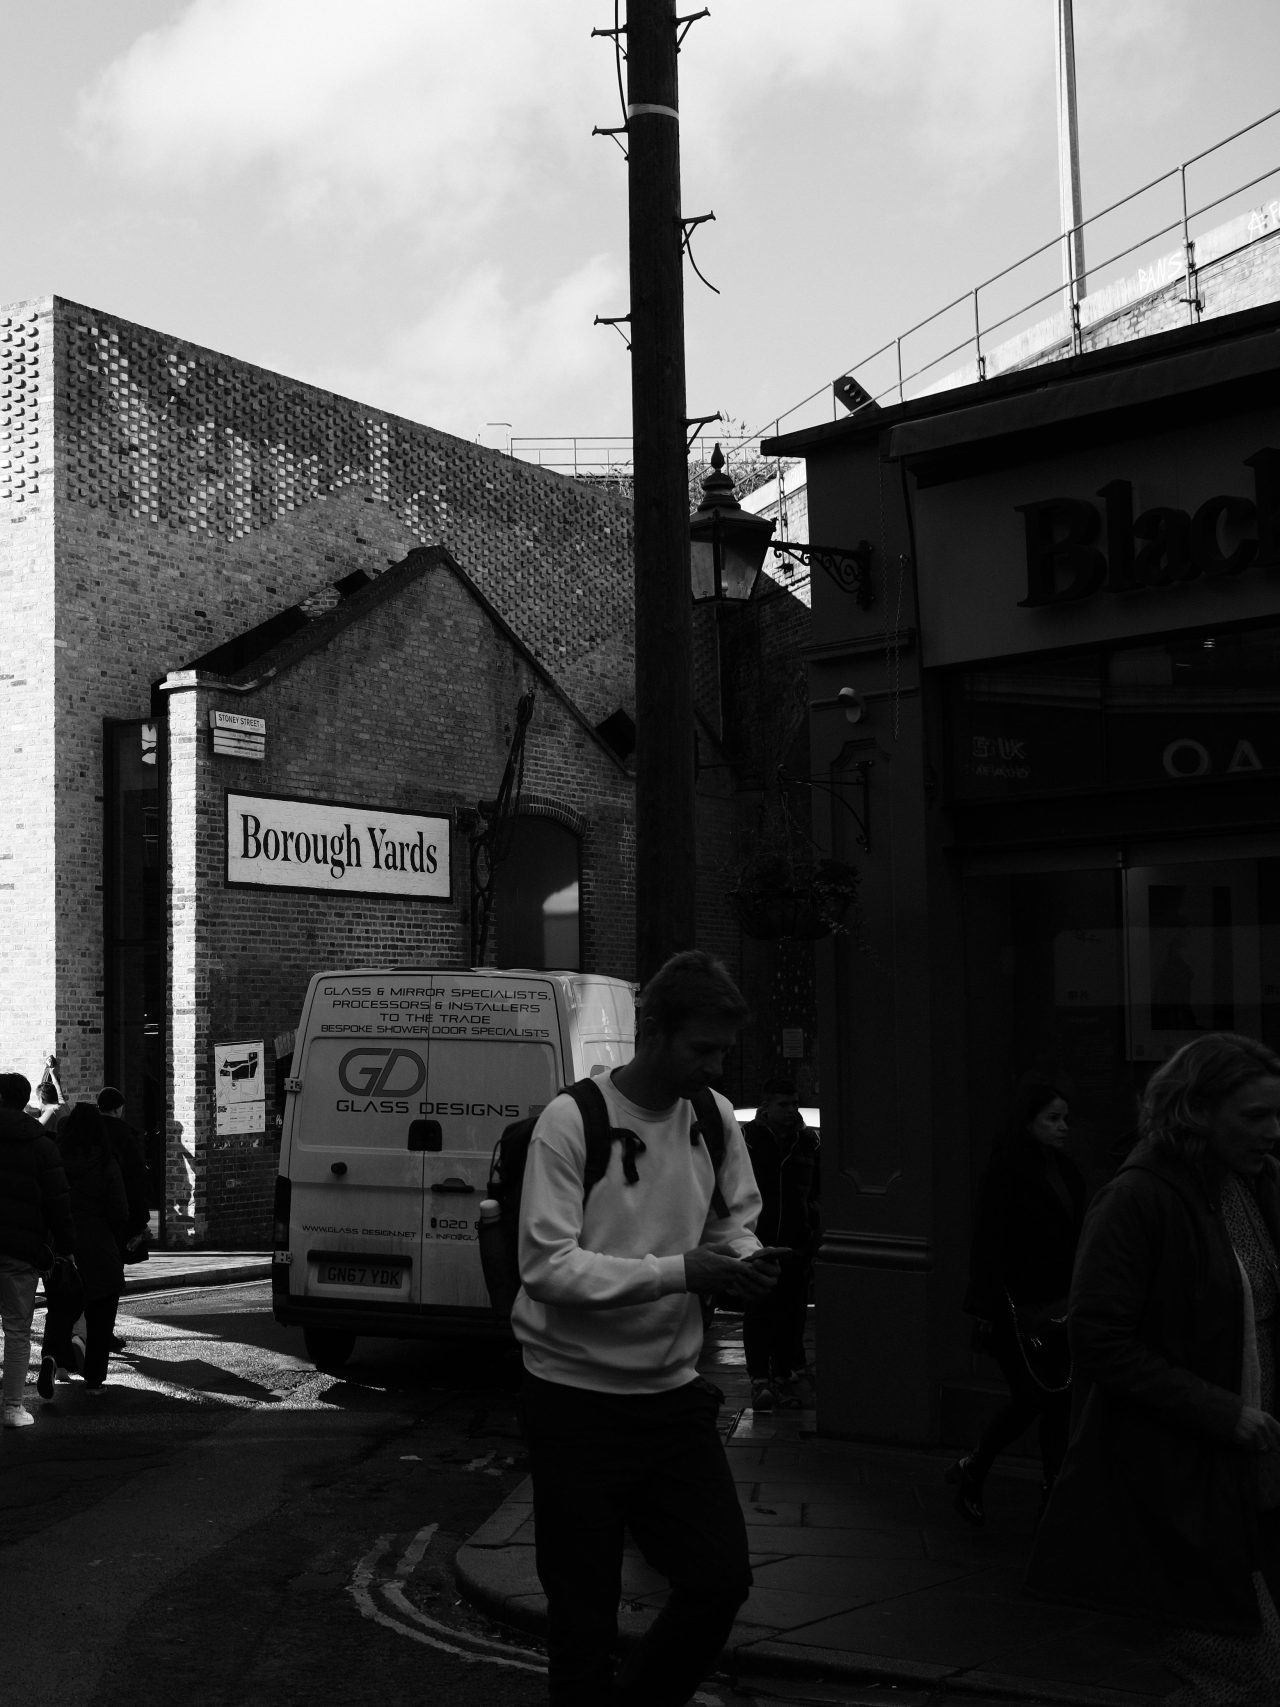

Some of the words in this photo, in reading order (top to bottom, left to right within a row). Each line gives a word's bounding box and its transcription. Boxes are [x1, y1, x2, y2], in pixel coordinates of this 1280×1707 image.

[218, 713, 239, 724] STONEY
[240, 717, 260, 728] STREET
[240, 813, 362, 880] Borough
[367, 827, 438, 874] Yards
[323, 987, 371, 997] GLASS
[376, 987, 384, 996] &
[390, 987, 445, 998] MIRROR
[332, 1000, 430, 1011] PROCESSORS
[435, 1001, 442, 1010] &
[448, 1002, 540, 1013] INSTALLERS
[380, 1013, 401, 1023] TO
[406, 1013, 433, 1023] THE
[440, 1014, 491, 1025] TRADE
[321, 1024, 373, 1034] BESPOKE
[377, 1025, 428, 1035] SHOWER
[432, 1026, 467, 1036] DOOR
[471, 1027, 549, 1038] SPECIALISTS
[338, 1047, 426, 1098] GD
[336, 1099, 409, 1114] GLASS
[419, 1101, 520, 1118] DESIGNS
[439, 1219, 468, 1230] 020
[327, 1267, 367, 1283] GN67
[371, 1268, 400, 1285] YDK
